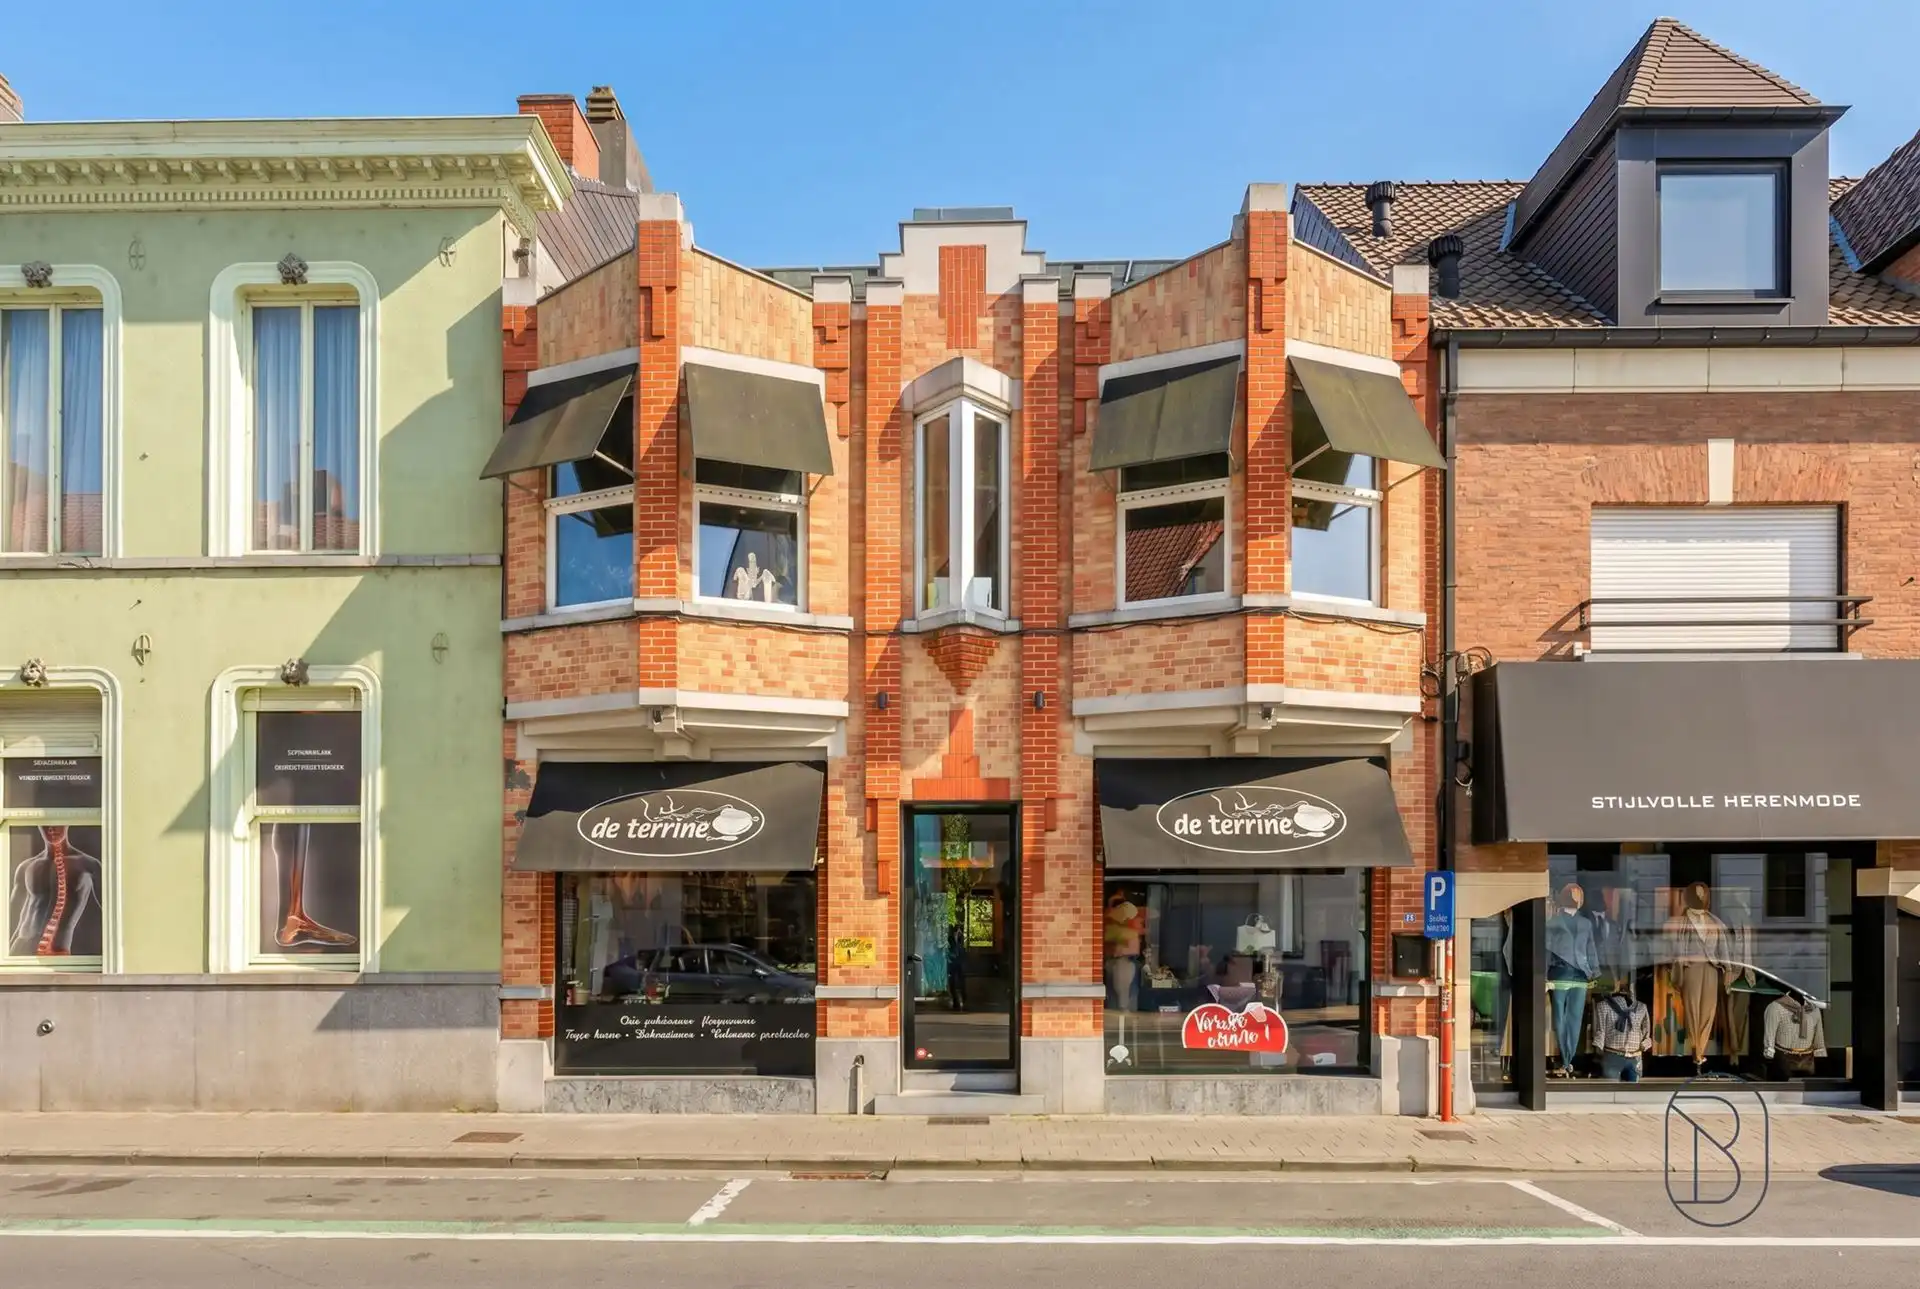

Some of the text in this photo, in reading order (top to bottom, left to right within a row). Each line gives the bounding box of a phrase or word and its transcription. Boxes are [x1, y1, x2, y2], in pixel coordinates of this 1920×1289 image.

[1591, 794, 1862, 809] STIJLVOLLE HERENMODE
[591, 816, 710, 839] de terrine
[1174, 813, 1294, 835] de terrine
[1430, 876, 1446, 911] P
